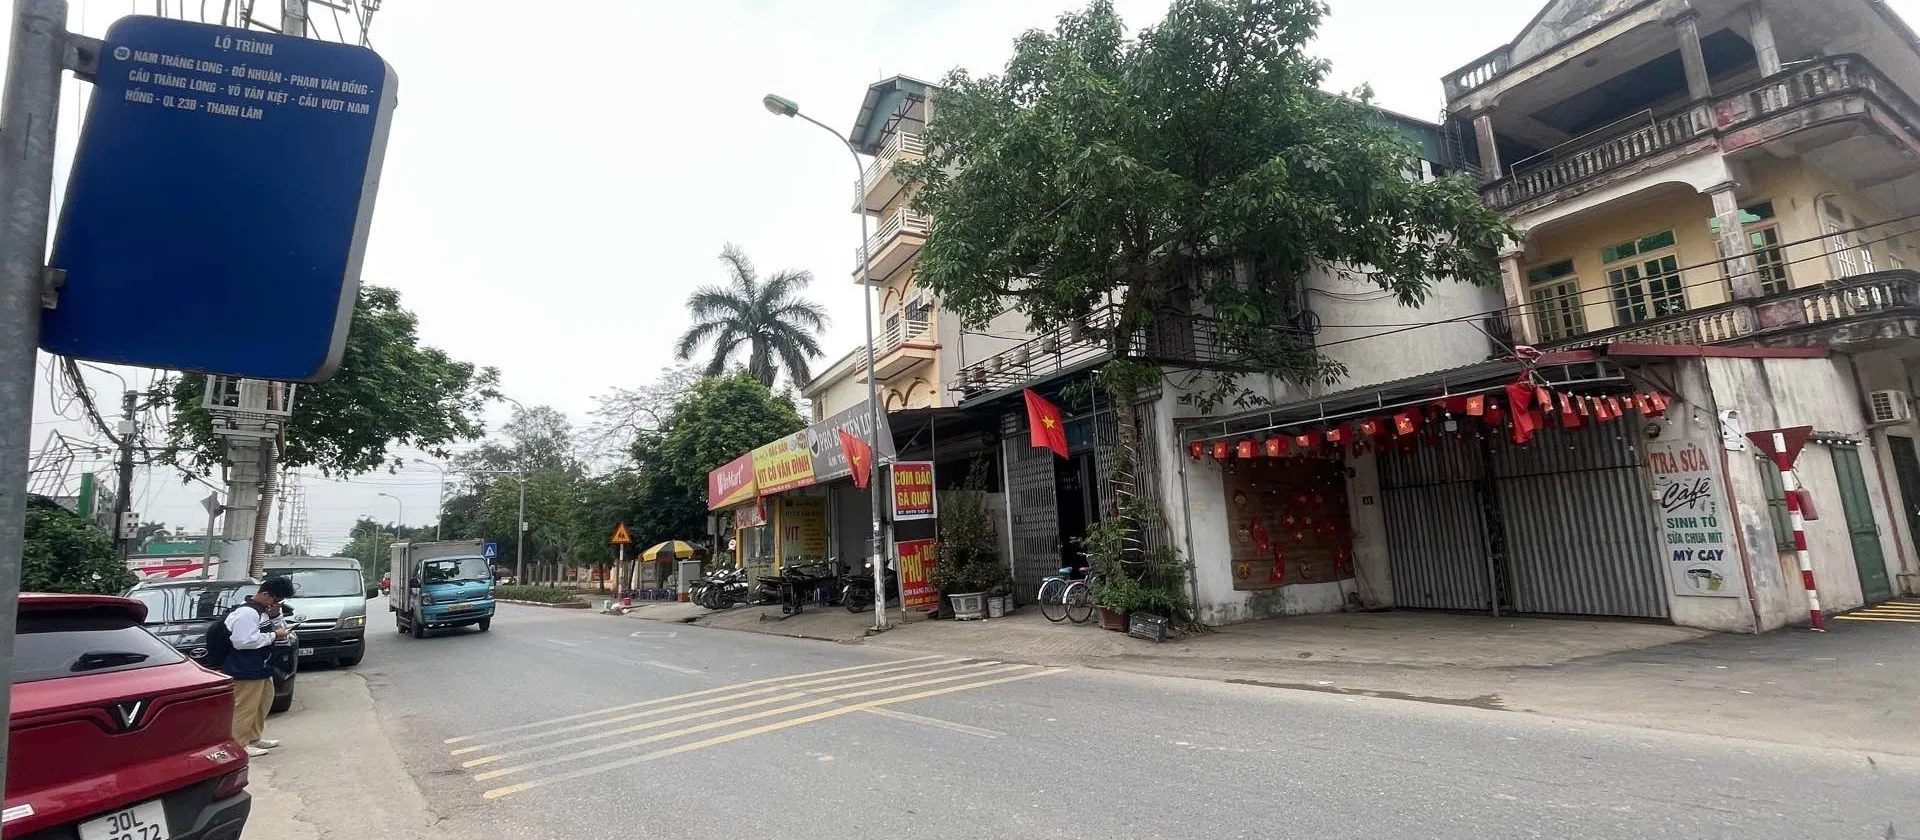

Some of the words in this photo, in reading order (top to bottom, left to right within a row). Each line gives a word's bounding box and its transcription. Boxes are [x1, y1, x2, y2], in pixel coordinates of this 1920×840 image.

[214, 34, 231, 52] LỘ
[236, 38, 274, 56] TRÌNH
[134, 50, 158, 64] NAM
[161, 53, 194, 70] THĂNG
[196, 60, 223, 74] LONG
[248, 68, 281, 85] NHUẬN
[290, 74, 319, 90] PHẠM
[321, 77, 340, 92] VĂN
[341, 79, 368, 95] ĐỒNG
[129, 68, 150, 83] CẦU
[154, 72, 187, 89] THĂNG
[190, 79, 217, 93] LONG
[228, 83, 241, 97] VÕ
[244, 86, 264, 100] VĂN
[267, 89, 289, 106] KIỆT
[298, 93, 318, 108] CẦU
[321, 98, 345, 113] VƯỢT
[347, 102, 370, 115] NAM
[125, 88, 153, 104] HỒNG
[163, 95, 175, 107] QL
[178, 98, 197, 111] 23B
[206, 102, 240, 117] THANH
[241, 106, 263, 120] LÂM
[1650, 445, 1679, 474] TRÀ
[1680, 442, 1710, 472] SỮA
[895, 469, 913, 486] CƠM
[1666, 516, 1697, 529] SINH
[1700, 511, 1717, 528] TỐ
[1685, 532, 1707, 544] CHUA
[1673, 547, 1694, 561] MỲ
[1697, 549, 1724, 561] CAY
[106, 809, 144, 835] 30L
